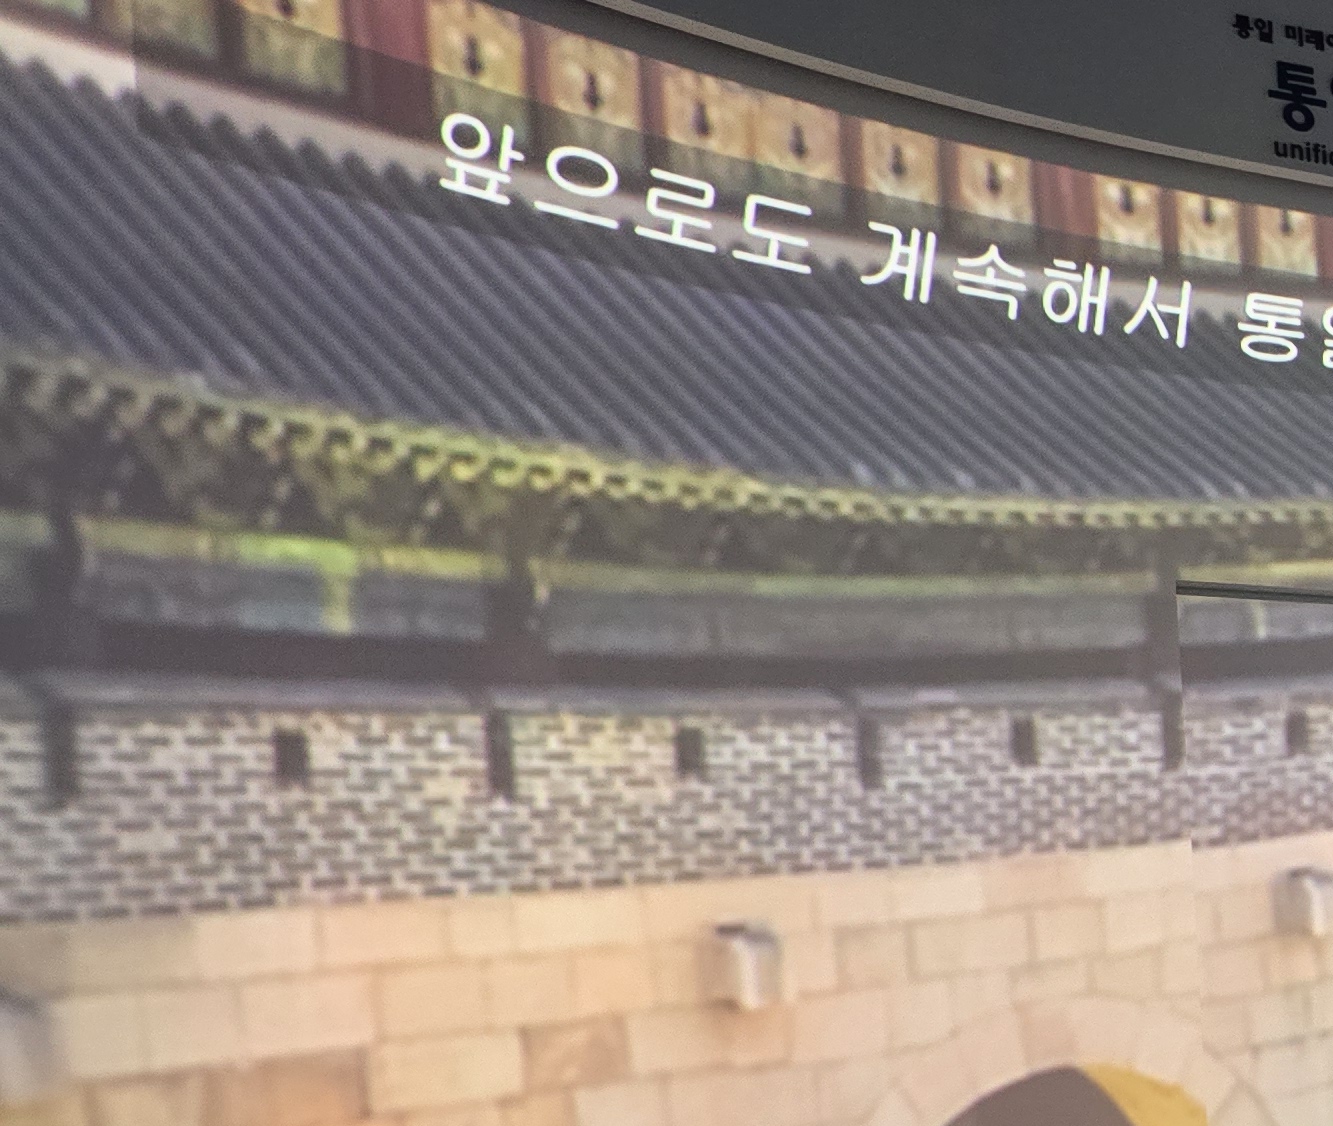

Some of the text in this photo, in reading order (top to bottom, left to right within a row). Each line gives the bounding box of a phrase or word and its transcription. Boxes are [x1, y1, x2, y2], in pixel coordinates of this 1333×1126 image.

[1232, 14, 1274, 44] 통일
[439, 111, 814, 275] 앞으로도
[859, 220, 1193, 350] 계속해서
